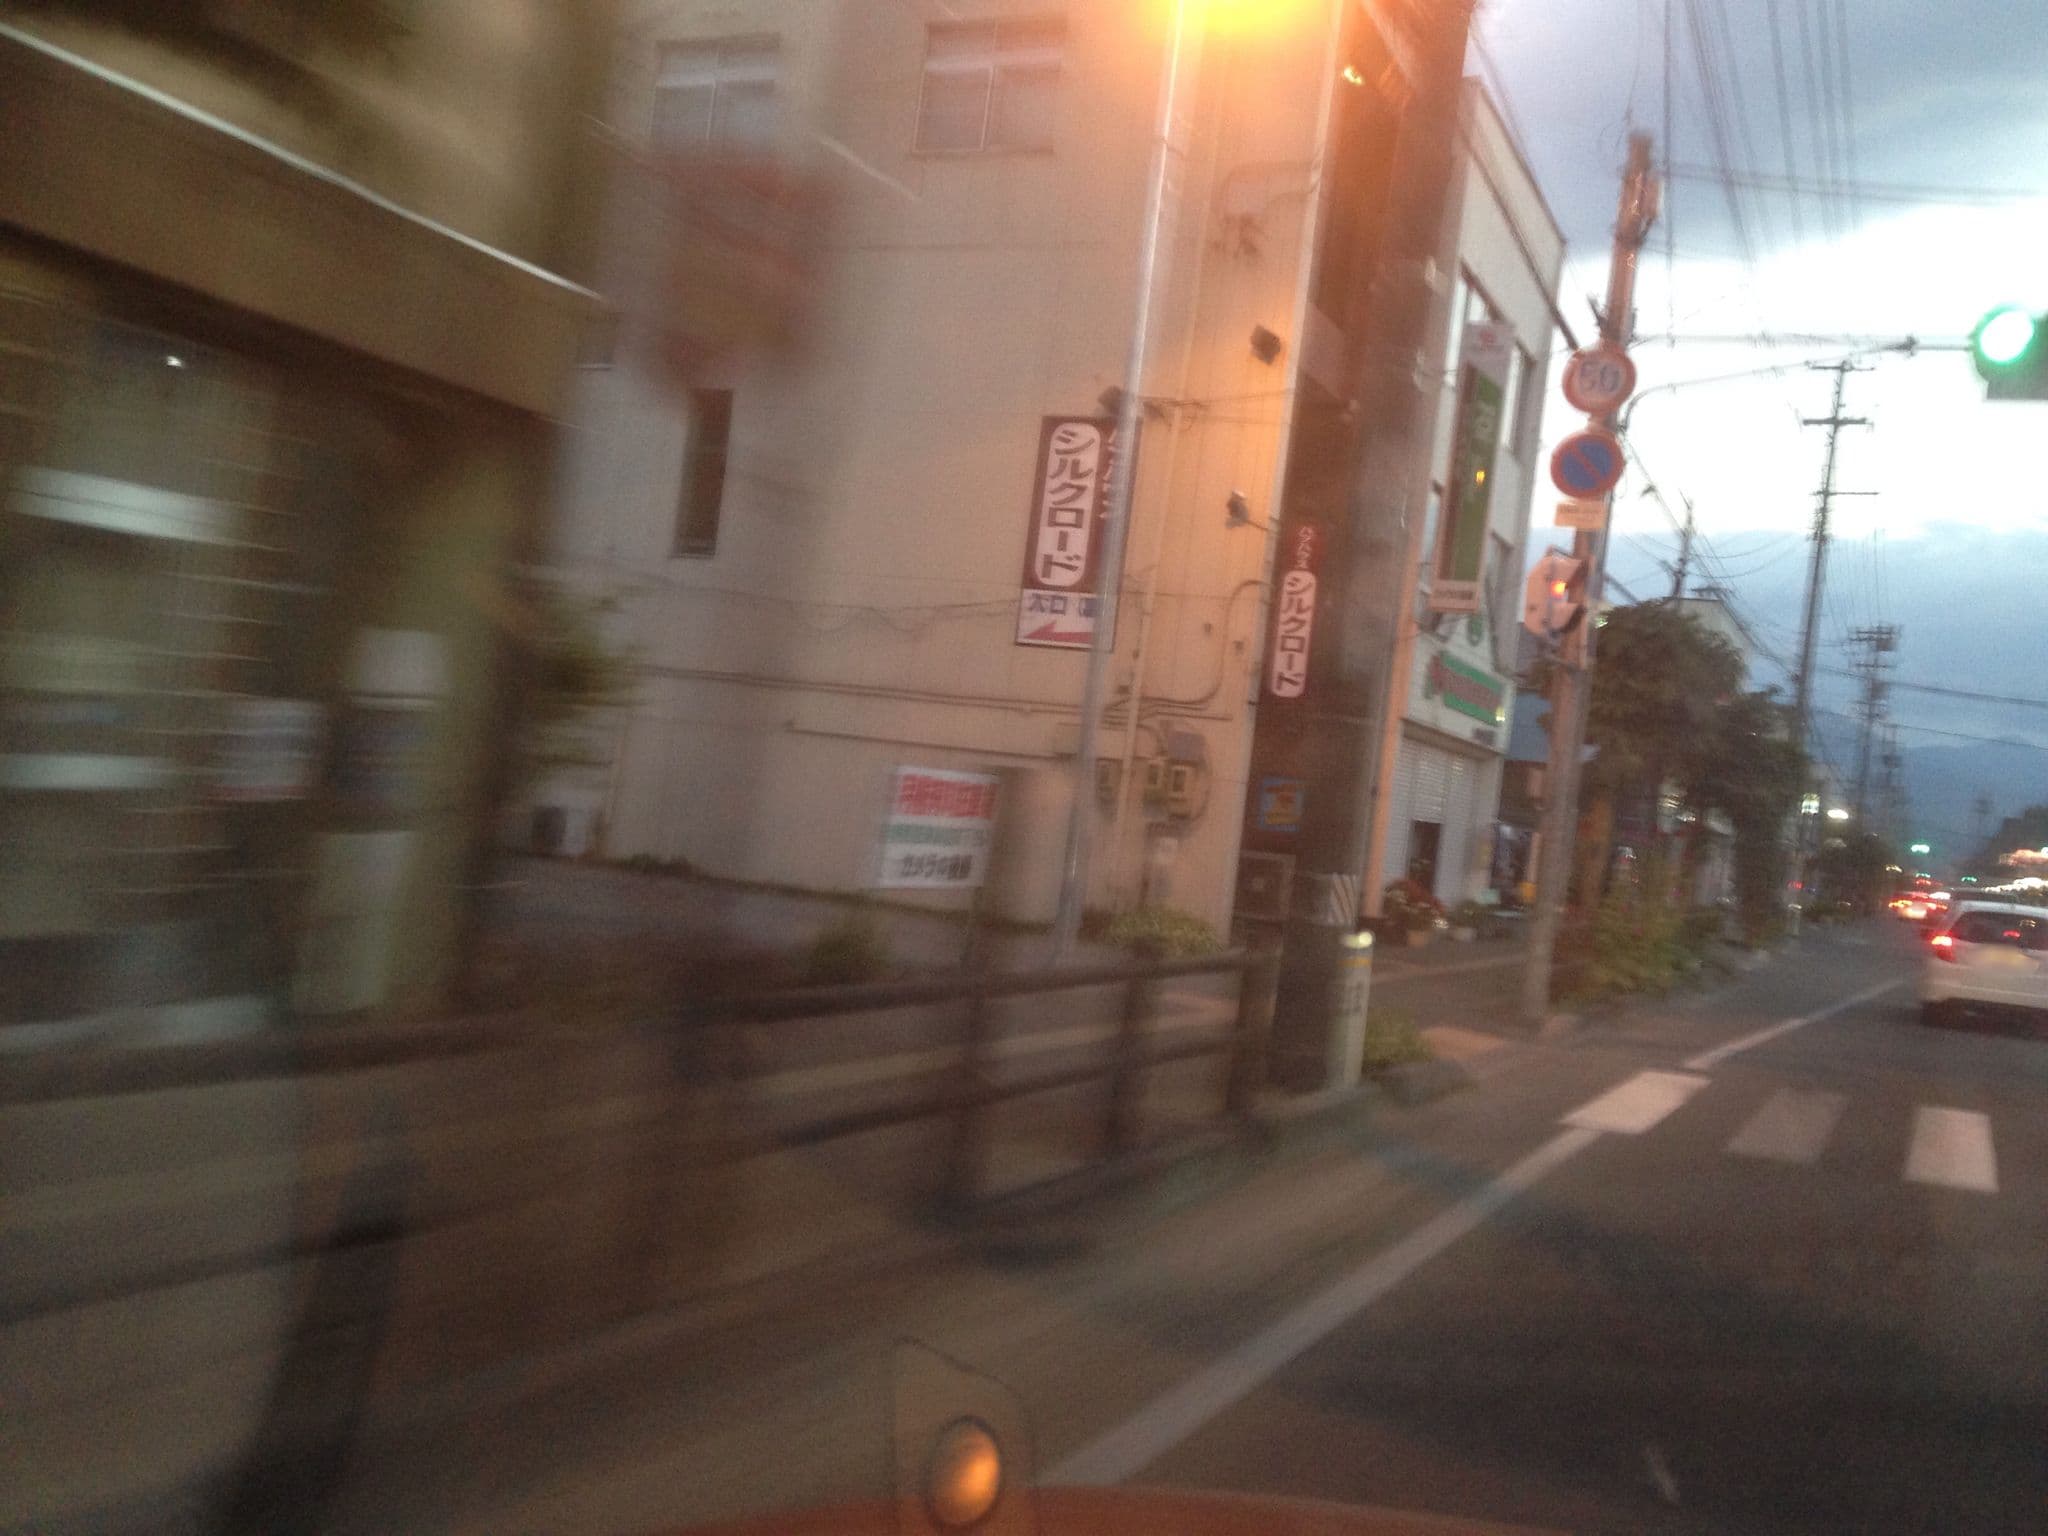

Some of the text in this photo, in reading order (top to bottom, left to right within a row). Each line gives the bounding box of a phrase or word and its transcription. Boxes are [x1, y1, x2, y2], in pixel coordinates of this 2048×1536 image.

[1041, 429, 1096, 580] シルクロード
